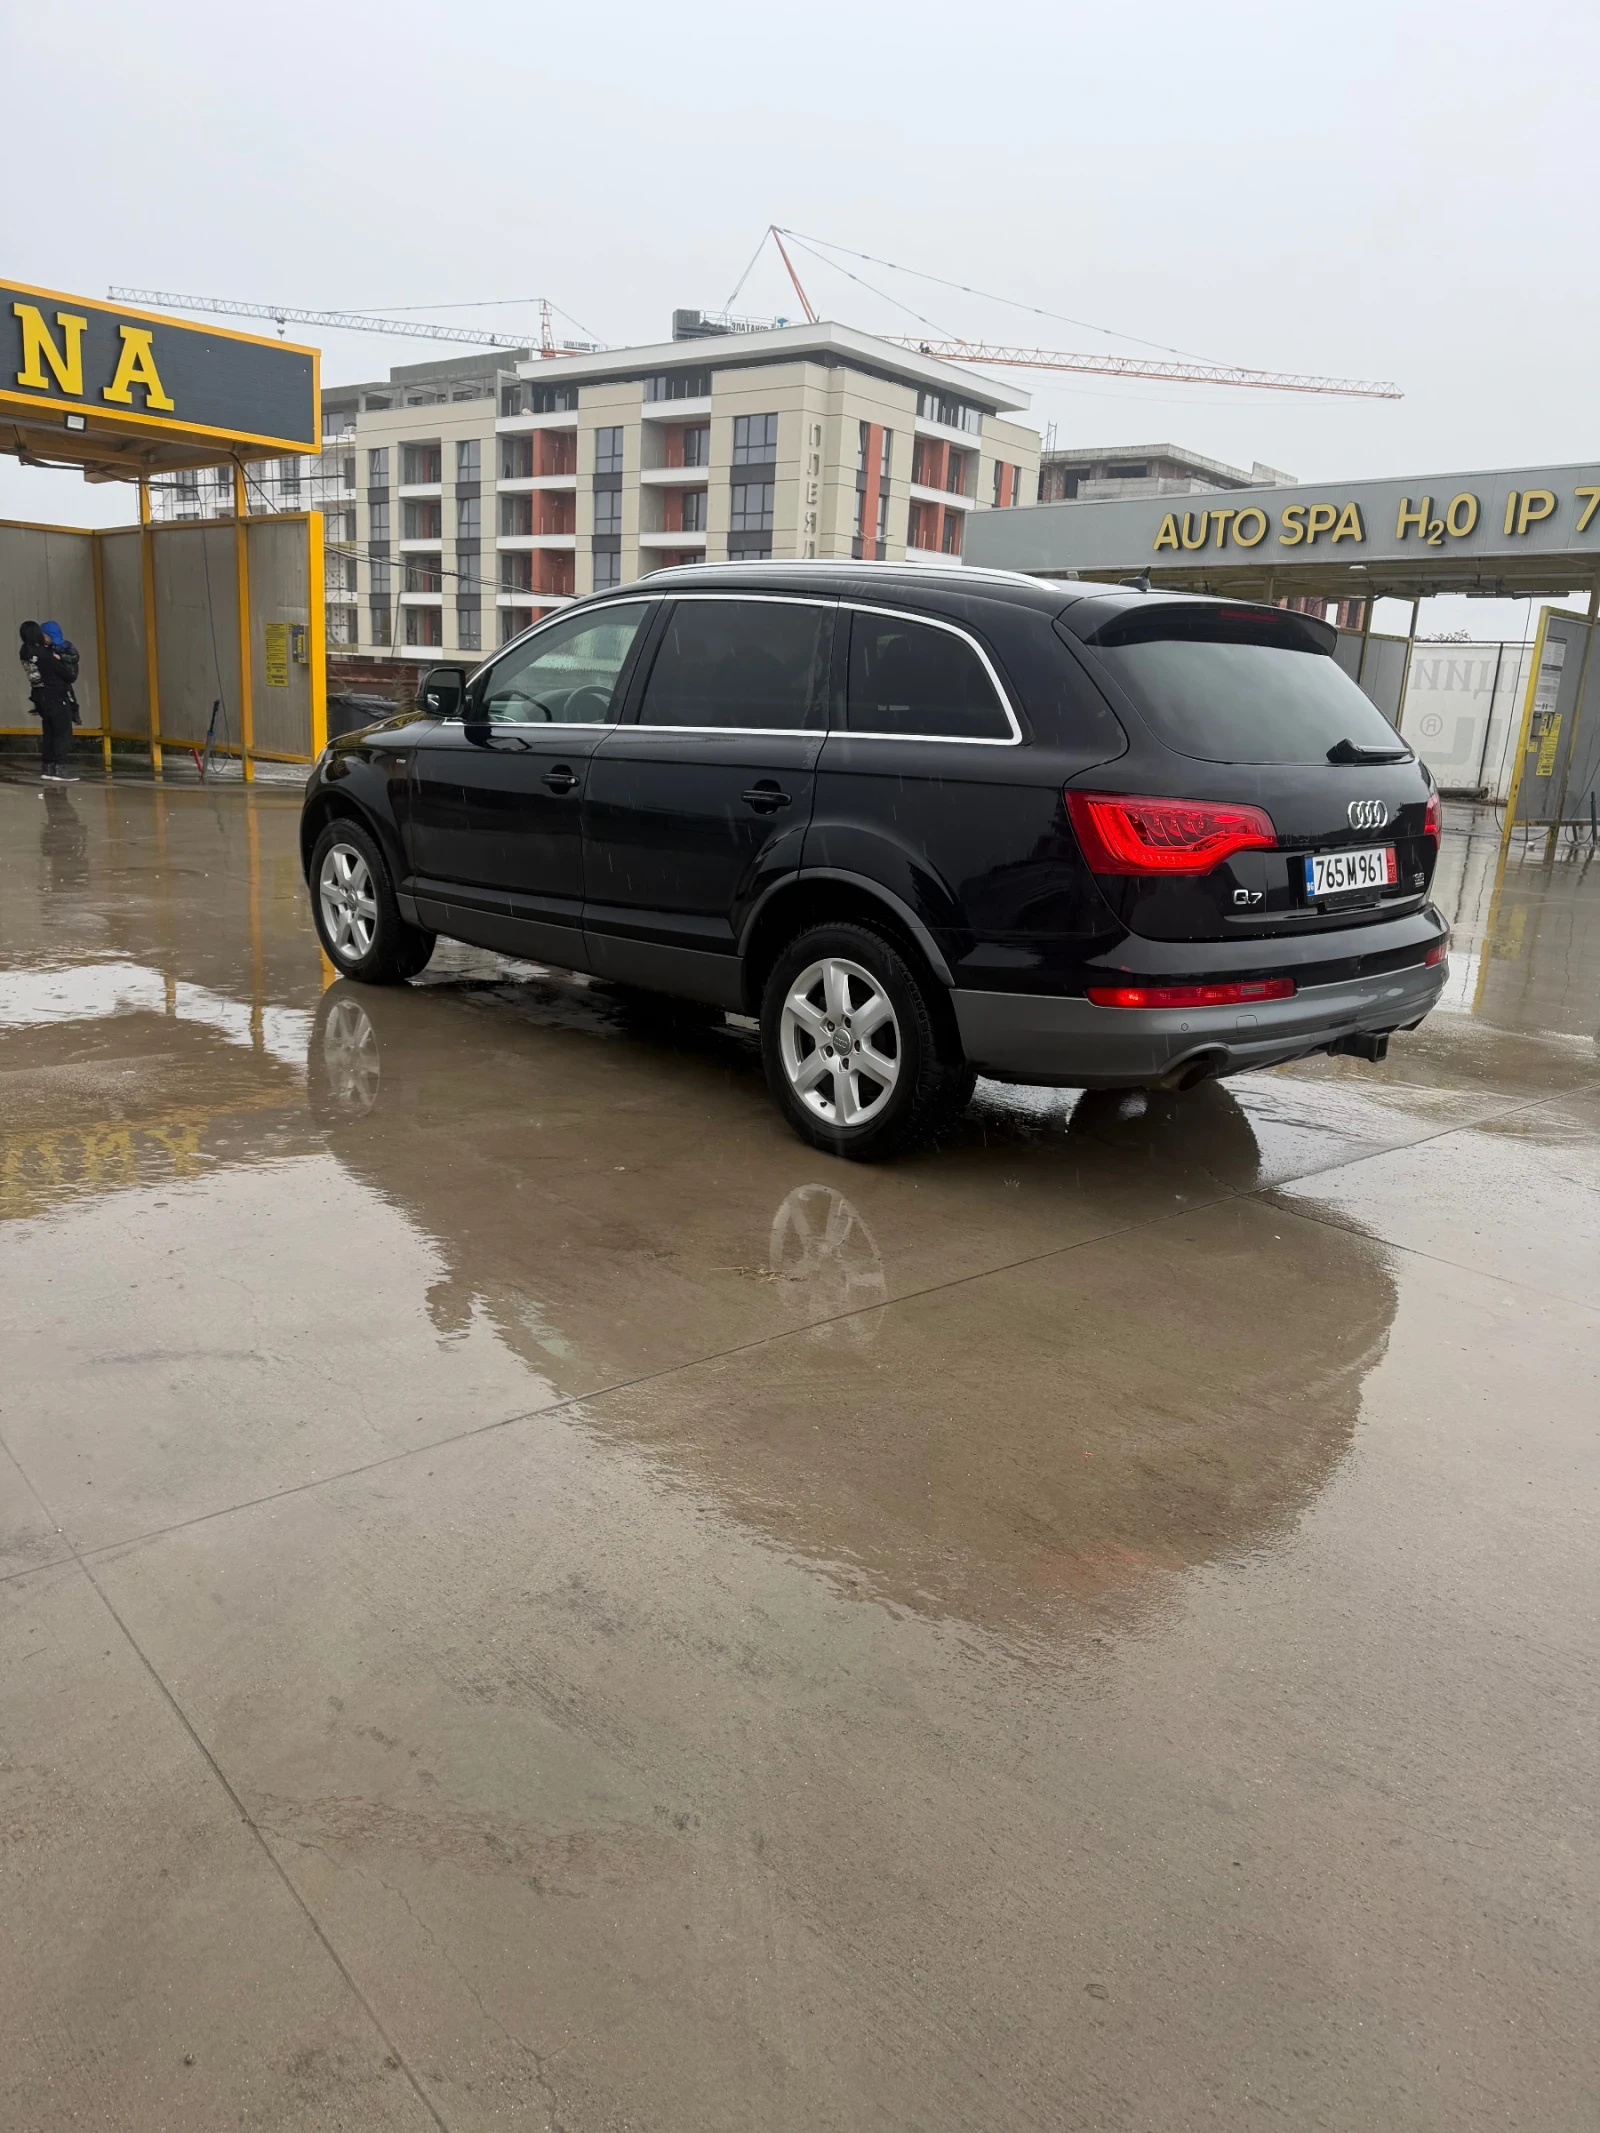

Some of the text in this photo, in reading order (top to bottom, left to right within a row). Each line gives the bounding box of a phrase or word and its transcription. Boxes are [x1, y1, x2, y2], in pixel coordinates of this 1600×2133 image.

[1153, 507, 1268, 550] AUTO
[1279, 502, 1364, 545] SPA
[1504, 489, 1557, 535] IP
[1233, 889, 1263, 905] Q7
